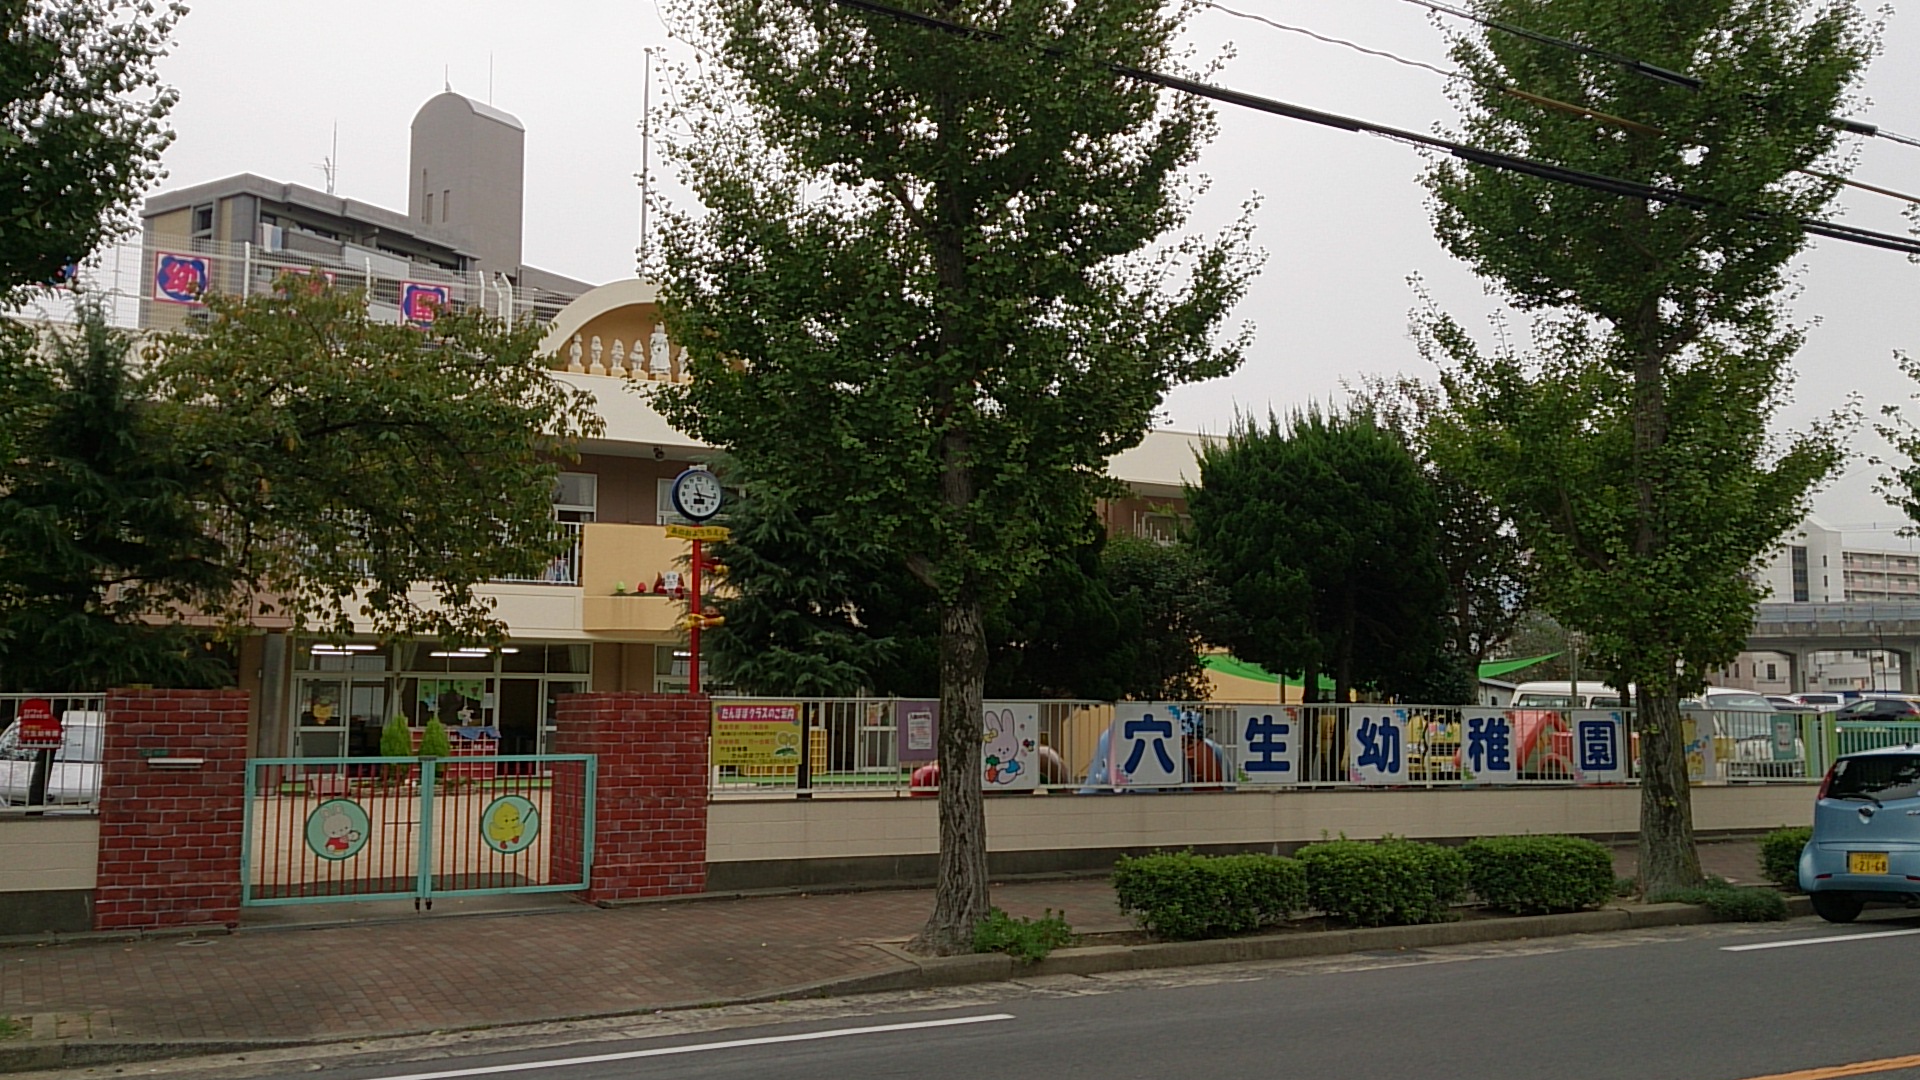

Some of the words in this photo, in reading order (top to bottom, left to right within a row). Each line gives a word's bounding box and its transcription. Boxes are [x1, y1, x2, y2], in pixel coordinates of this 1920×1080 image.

[1123, 713, 1617, 775] 穴生幼稚園
